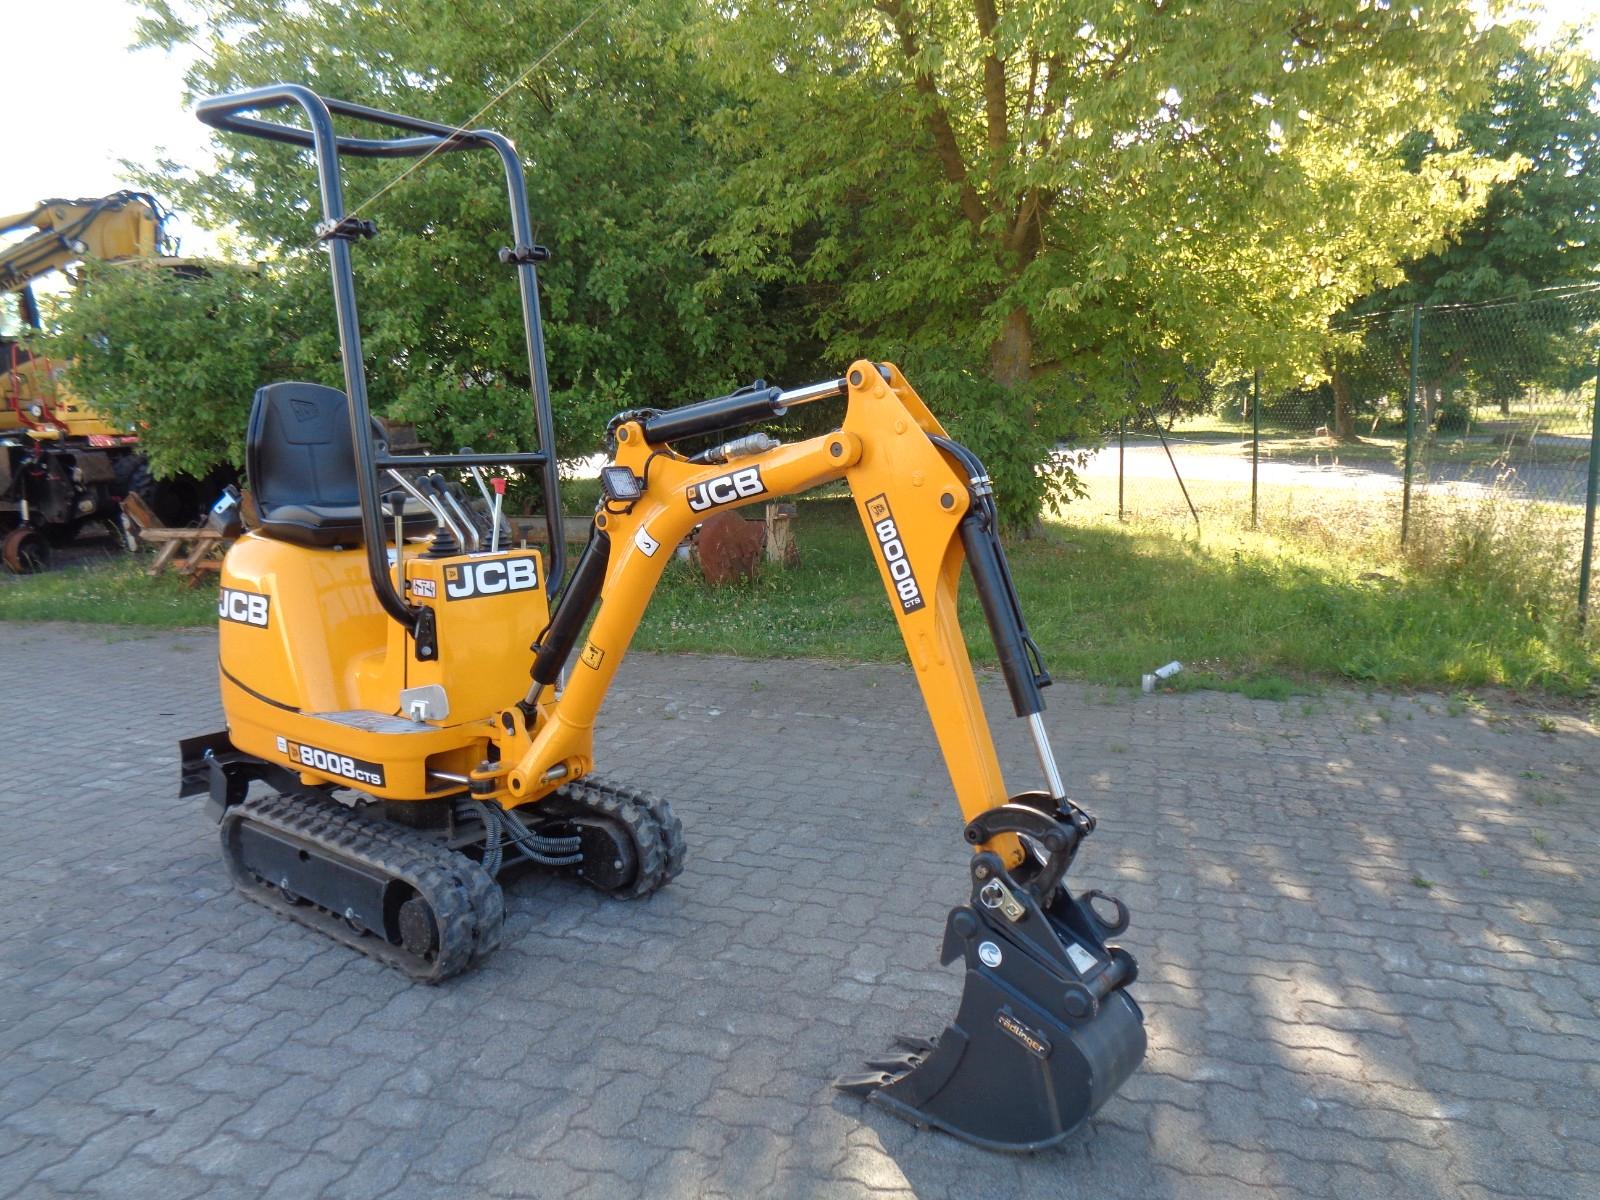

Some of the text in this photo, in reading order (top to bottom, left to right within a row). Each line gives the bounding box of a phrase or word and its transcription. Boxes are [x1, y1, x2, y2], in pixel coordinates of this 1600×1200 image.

[689, 468, 764, 511] JCB
[447, 558, 537, 598] JCB
[876, 519, 918, 601] 8008
[218, 590, 268, 626] JCB
